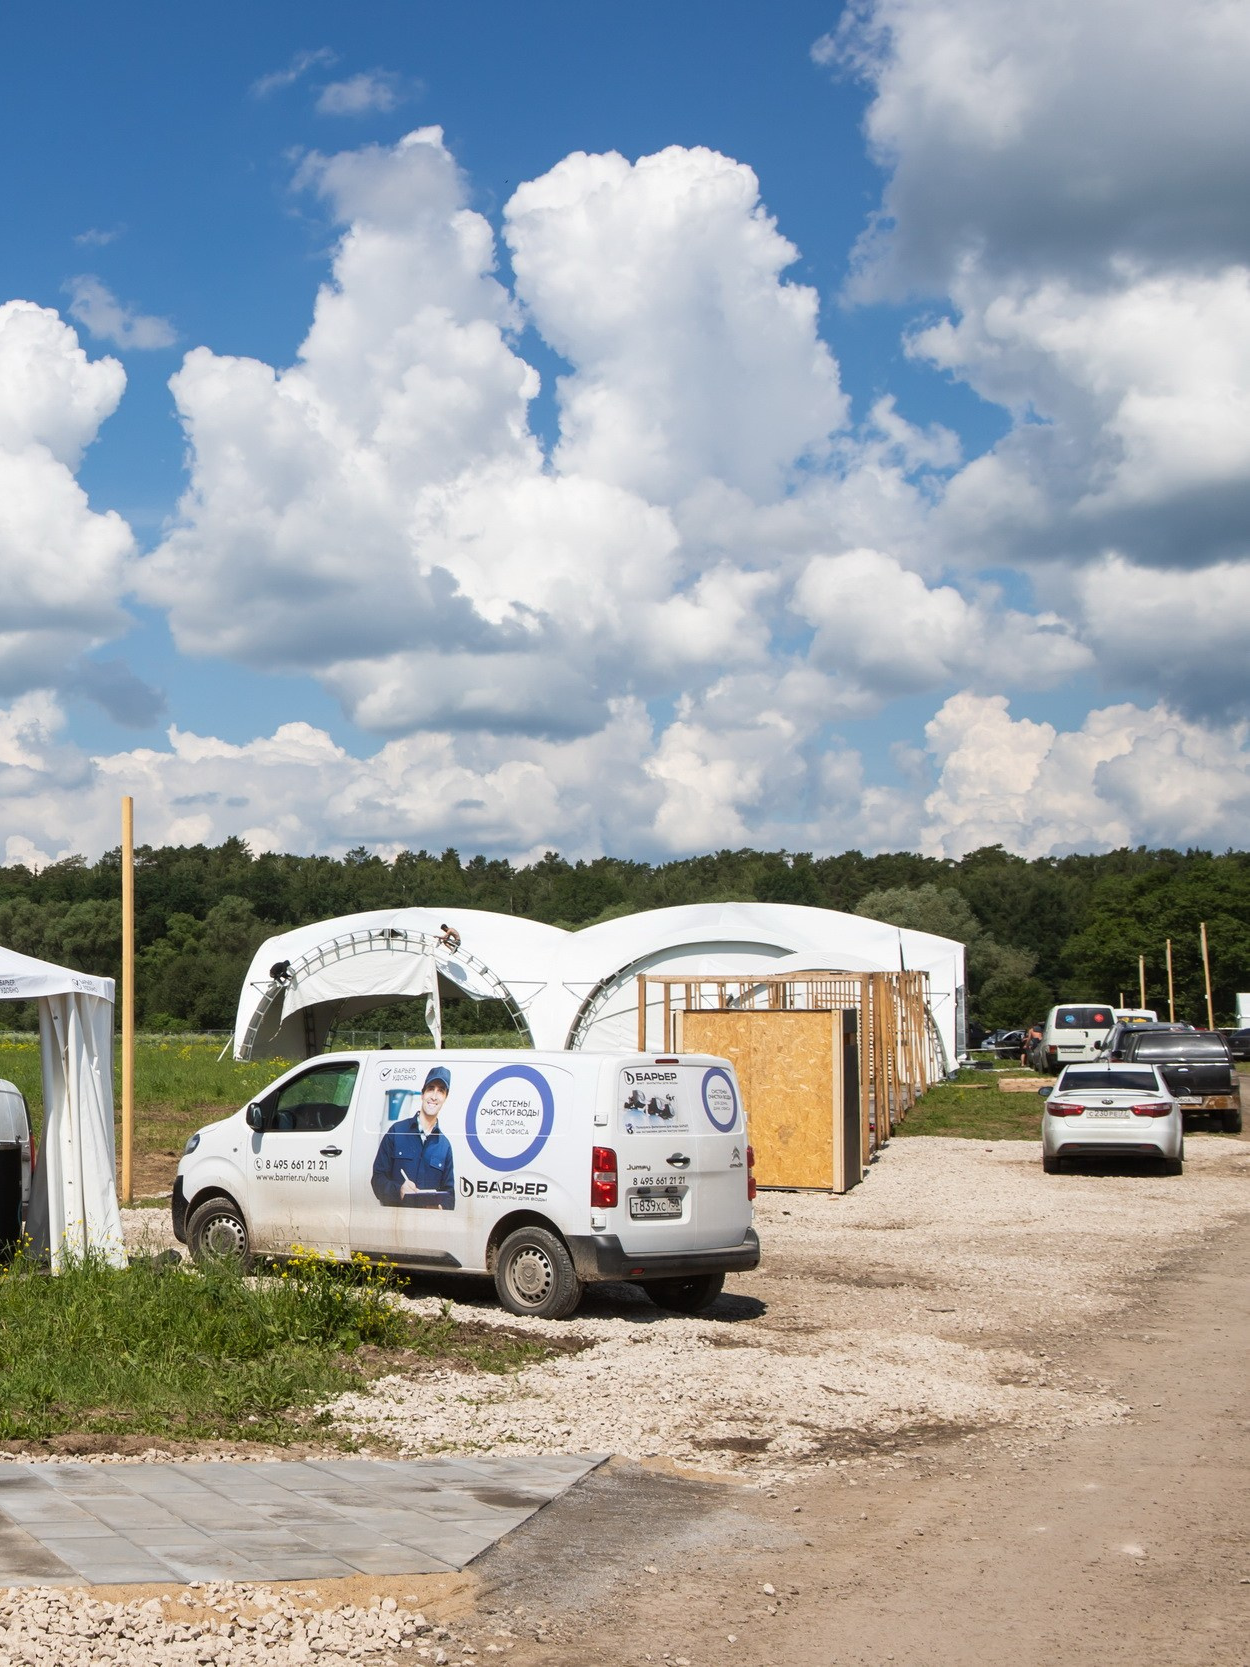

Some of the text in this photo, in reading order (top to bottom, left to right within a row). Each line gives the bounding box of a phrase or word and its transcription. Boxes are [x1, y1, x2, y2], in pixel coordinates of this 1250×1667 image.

[635, 1072, 677, 1081] БАРЬЕР
[491, 1099, 530, 1107] СИСТЕМЫ
[480, 1108, 540, 1117] ОЧИСТКИ ВОДЫ
[273, 1159, 288, 1170] 495
[291, 1160, 304, 1170] 661
[307, 1160, 316, 1170] 21
[319, 1160, 328, 1170] 21
[256, 1173, 329, 1182] www.barrier.ru/house
[640, 1177, 654, 1185] 495
[655, 1177, 667, 1185] 661
[669, 1176, 677, 1185] 21
[678, 1176, 686, 1185] 21
[476, 1180, 548, 1195] БАРЬЕР
